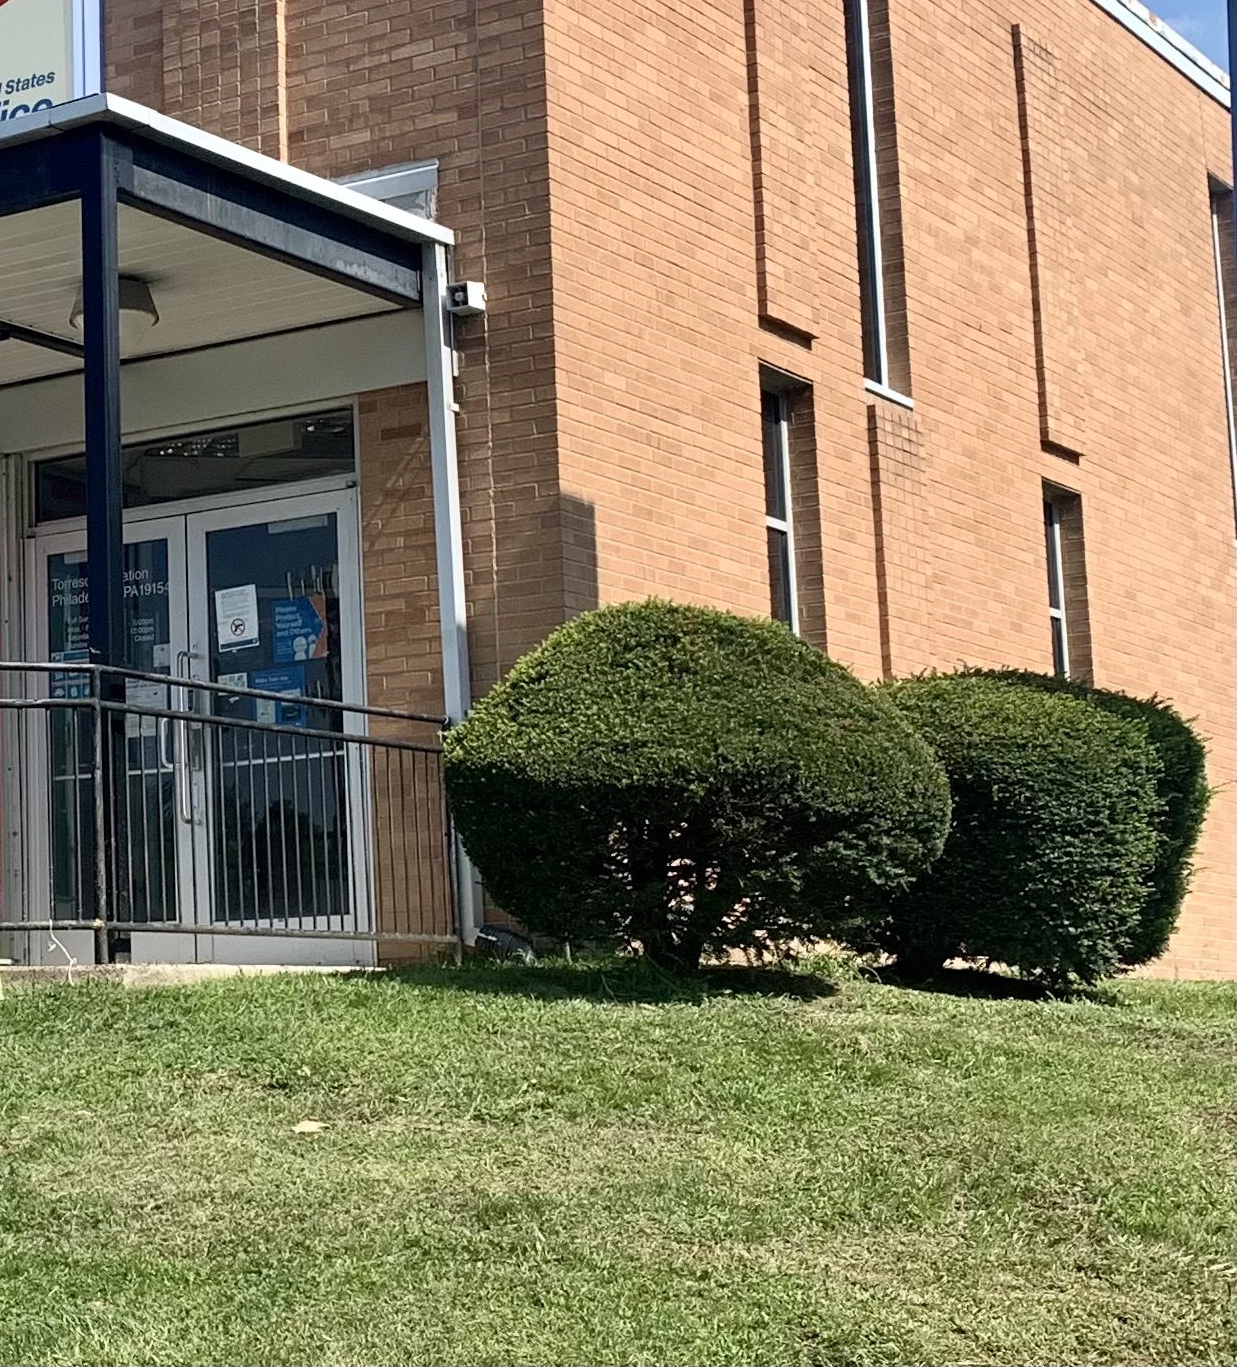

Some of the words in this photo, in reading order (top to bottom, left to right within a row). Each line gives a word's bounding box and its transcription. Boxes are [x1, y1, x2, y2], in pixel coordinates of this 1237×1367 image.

[4, 70, 56, 95] States
[51, 577, 89, 592] Torres
[123, 570, 148, 583] ation
[52, 591, 90, 607] Philade
